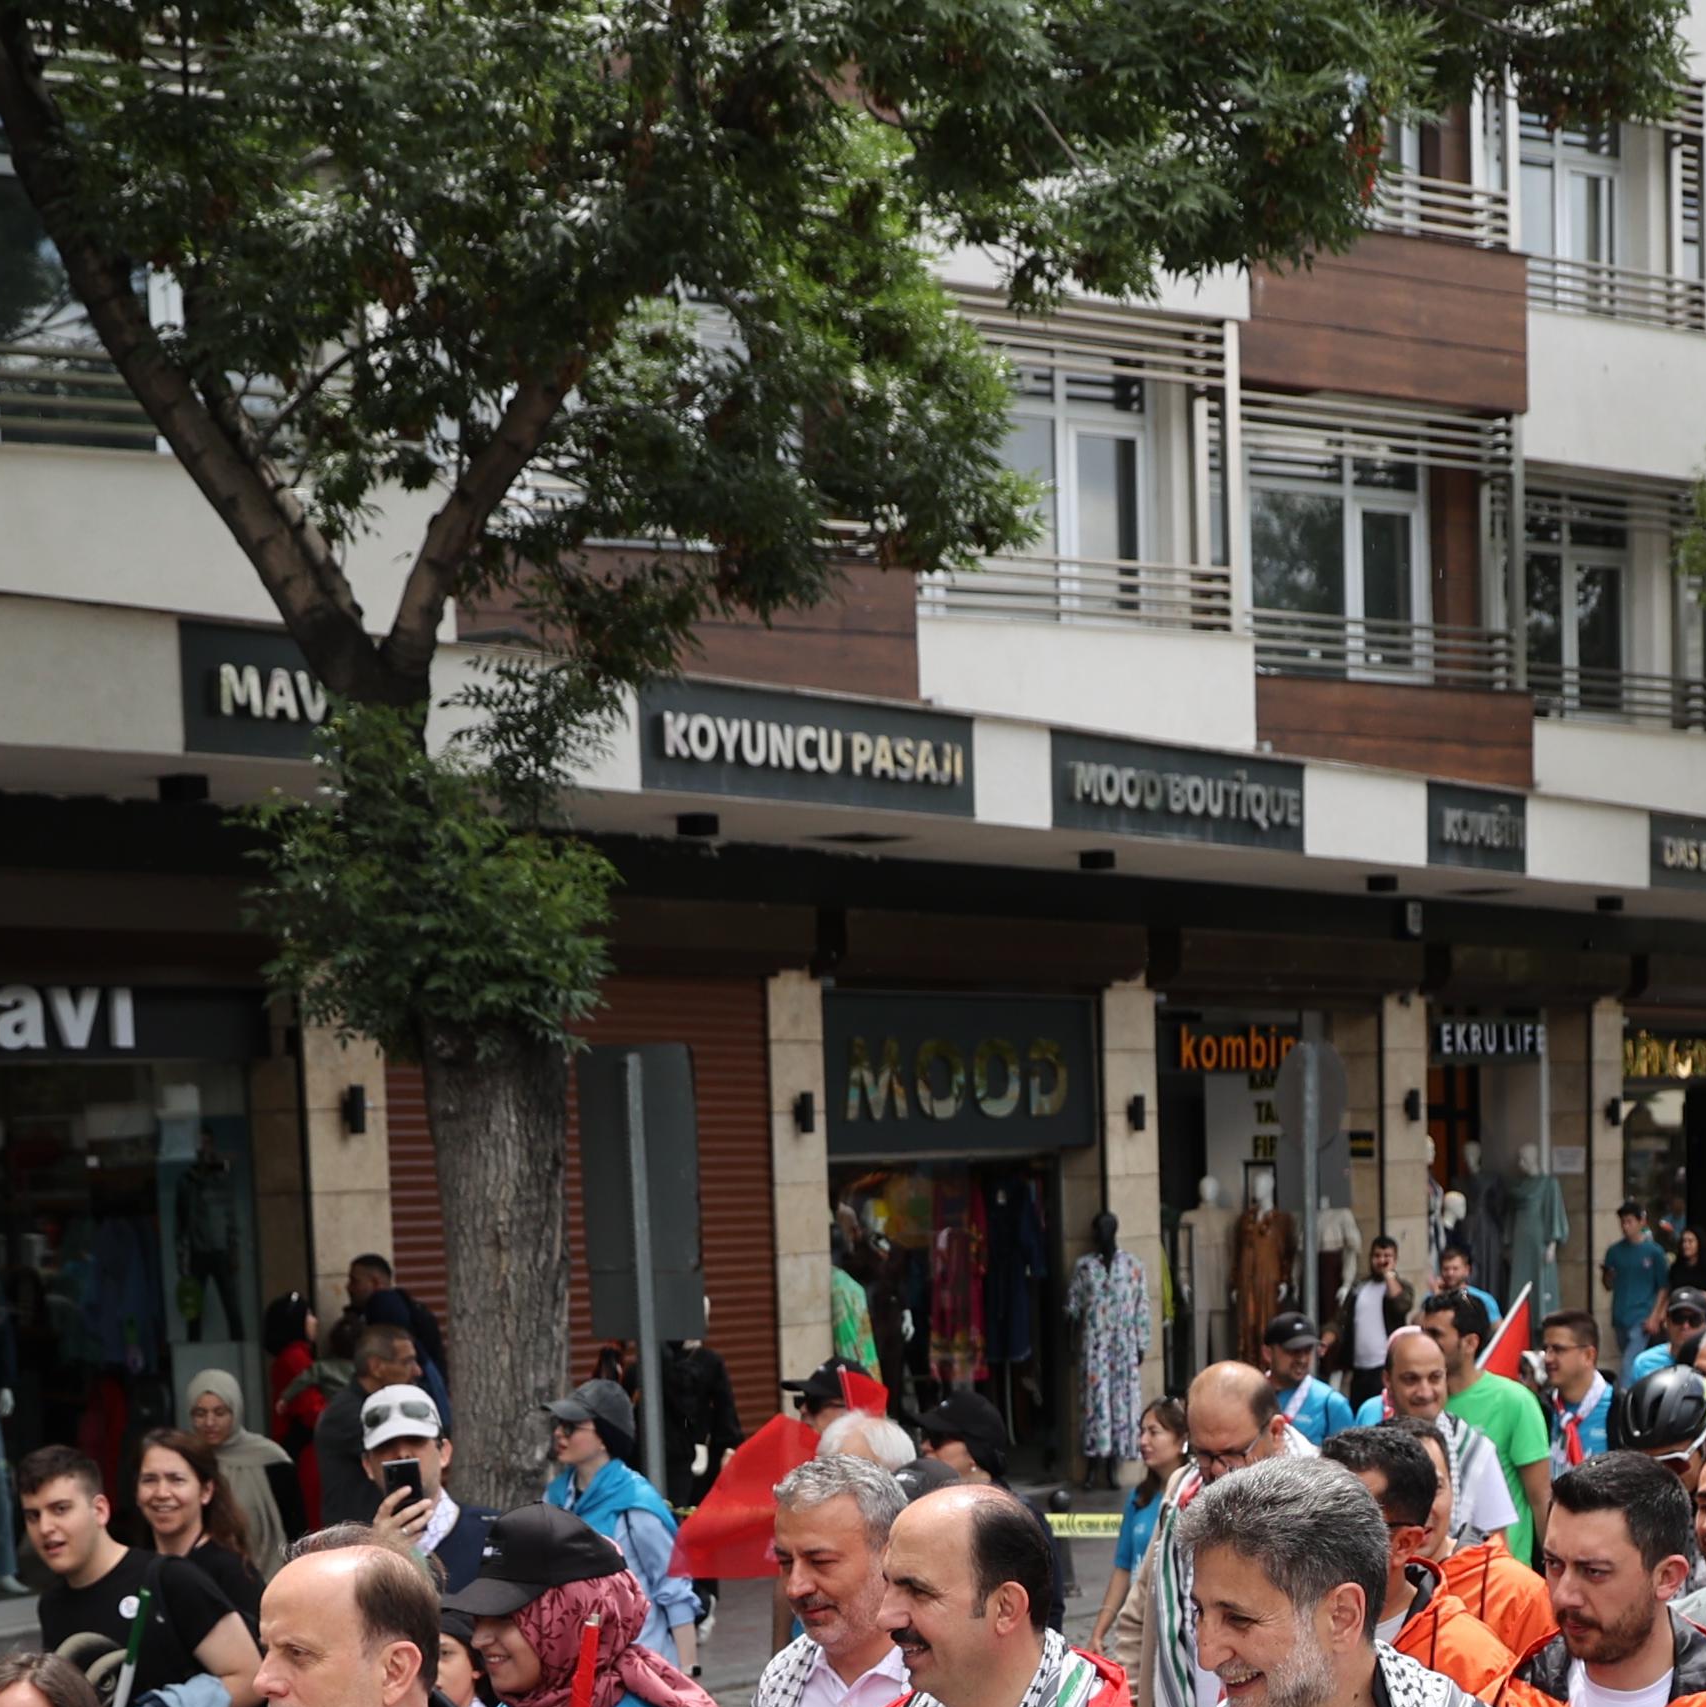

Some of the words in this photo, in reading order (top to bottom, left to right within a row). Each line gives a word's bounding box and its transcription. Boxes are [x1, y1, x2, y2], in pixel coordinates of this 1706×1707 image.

[663, 710, 842, 774] KOYUNCU
[850, 731, 963, 785] PASAJI
[1071, 760, 1162, 810] MOOD
[1441, 1023, 1498, 1055] EKRU
[844, 1037, 1068, 1122] MOOD
